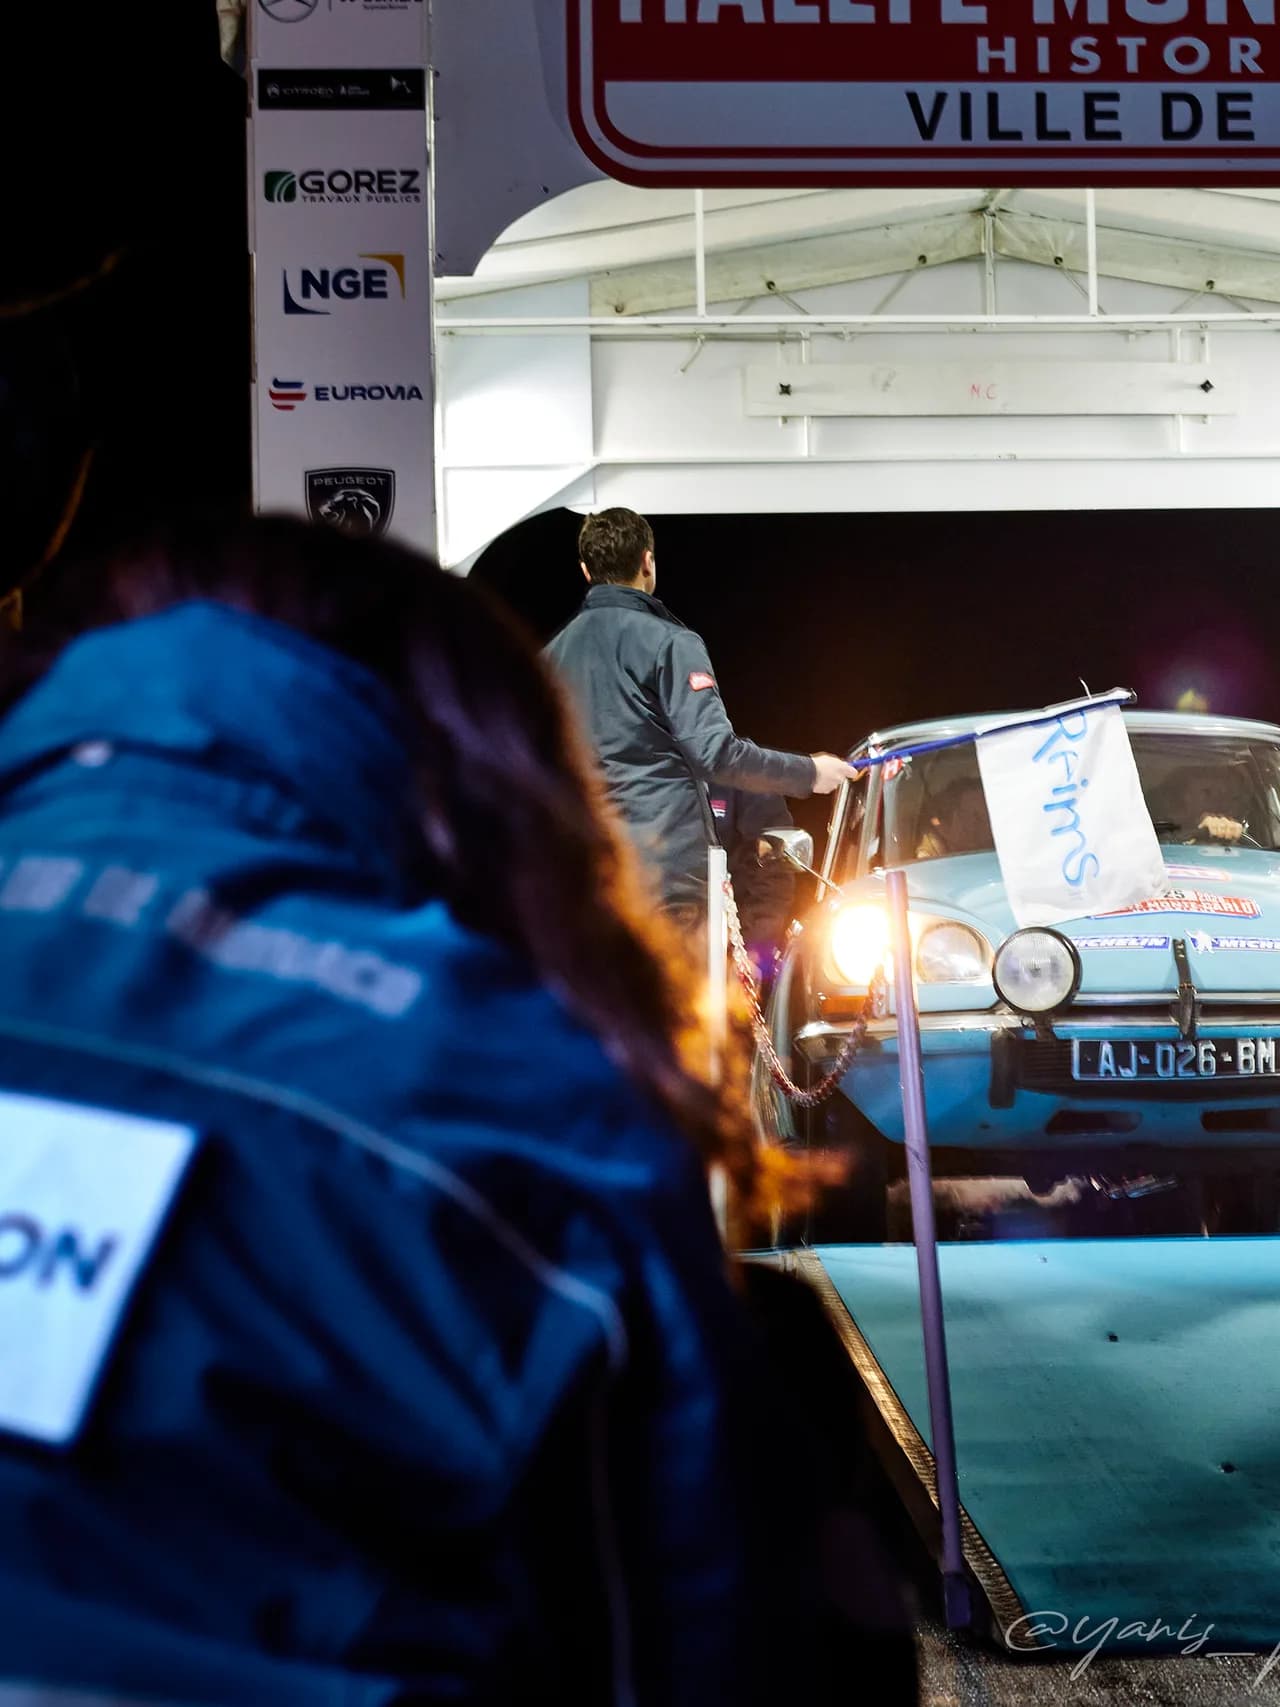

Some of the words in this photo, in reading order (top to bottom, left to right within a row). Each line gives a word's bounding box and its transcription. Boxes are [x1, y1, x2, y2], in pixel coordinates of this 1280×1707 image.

[905, 91, 1123, 142] VILLE
[1161, 91, 1256, 142] DE
[299, 169, 421, 195] GOREZ
[301, 195, 360, 204] TRAVAUX
[366, 195, 421, 204] PUBLICS
[301, 268, 389, 300] NGE
[313, 384, 424, 402] EUROVIA
[313, 476, 386, 487] PEUGEOT
[1098, 1036, 1276, 1079] AJ-026-BM
